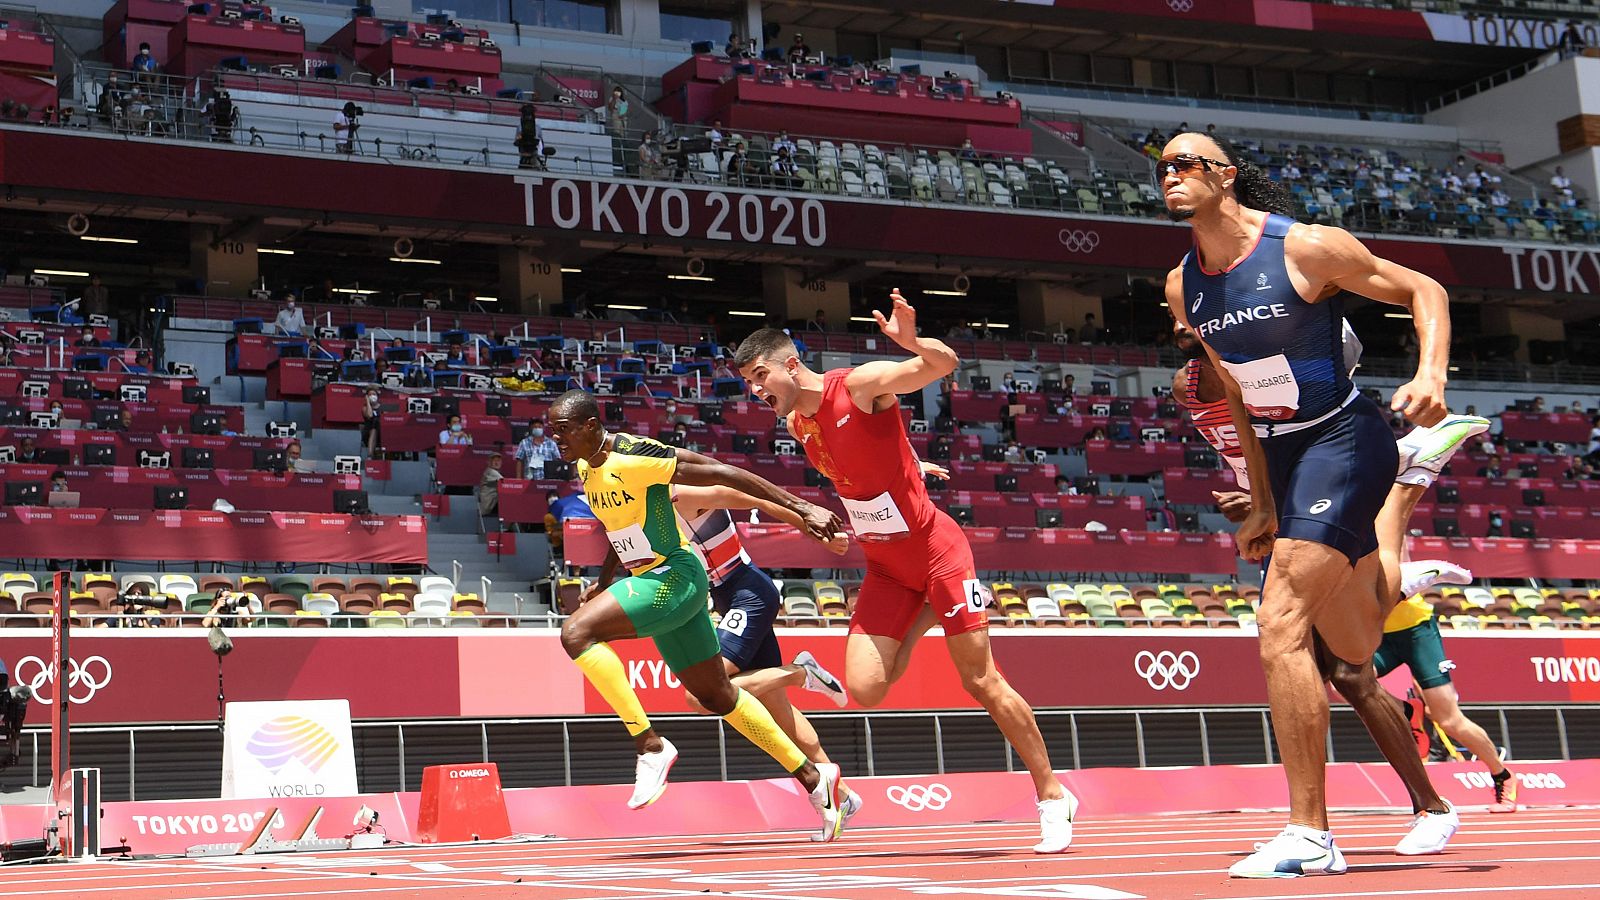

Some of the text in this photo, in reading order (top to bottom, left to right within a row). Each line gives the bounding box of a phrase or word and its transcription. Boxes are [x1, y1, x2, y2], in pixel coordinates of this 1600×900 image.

[1464, 12, 1557, 49] TOKYO
[514, 175, 827, 247] TOKYO 2020
[221, 242, 244, 255] 110
[530, 263, 551, 276] 110
[1200, 303, 1290, 338] FRANCE
[1241, 373, 1292, 390] OT-LAGARDE
[1198, 424, 1241, 451] US
[850, 507, 893, 522] MARTINEZ
[612, 537, 635, 553] EVY
[971, 583, 983, 608] 6
[727, 612, 743, 630] 8
[628, 660, 682, 689] KYO
[1531, 657, 1600, 683] TOKYO
[459, 769, 489, 778] OMEGA
[1453, 772, 1566, 790] TOK 2020
[268, 784, 325, 797] WORLD
[132, 815, 219, 835] TOKYO
